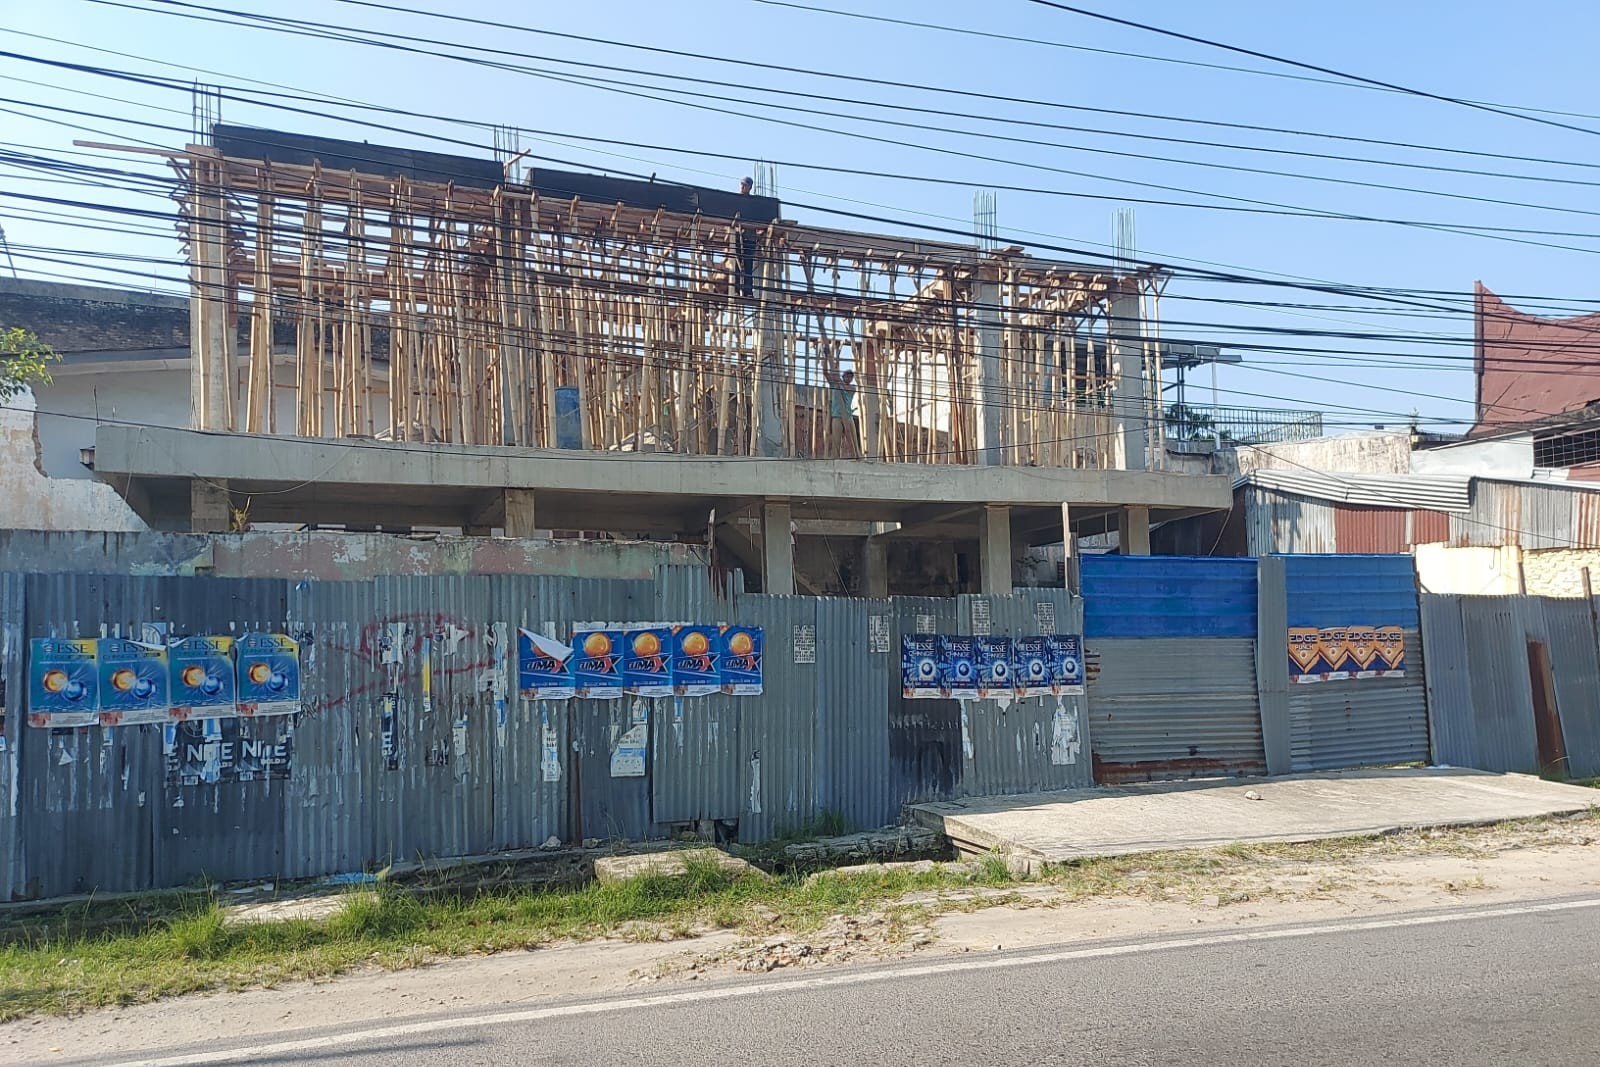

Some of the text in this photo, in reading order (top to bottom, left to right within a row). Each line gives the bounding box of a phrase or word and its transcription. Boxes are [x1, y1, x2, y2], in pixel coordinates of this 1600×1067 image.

[1289, 634, 1318, 642] EDGE
[1320, 631, 1346, 640] EDGE
[1347, 632, 1373, 640] EDGE
[1375, 632, 1401, 640] EDGE
[194, 640, 225, 650] ESSE
[260, 637, 288, 648] ESSE
[916, 642, 935, 651] ESSE
[953, 643, 971, 651] ESSE
[1059, 641, 1076, 650] ESSE
[57, 643, 89, 654] ESSE
[123, 643, 154, 653] ESS
[991, 644, 1007, 653] ESSE
[1025, 643, 1042, 652] ESSE
